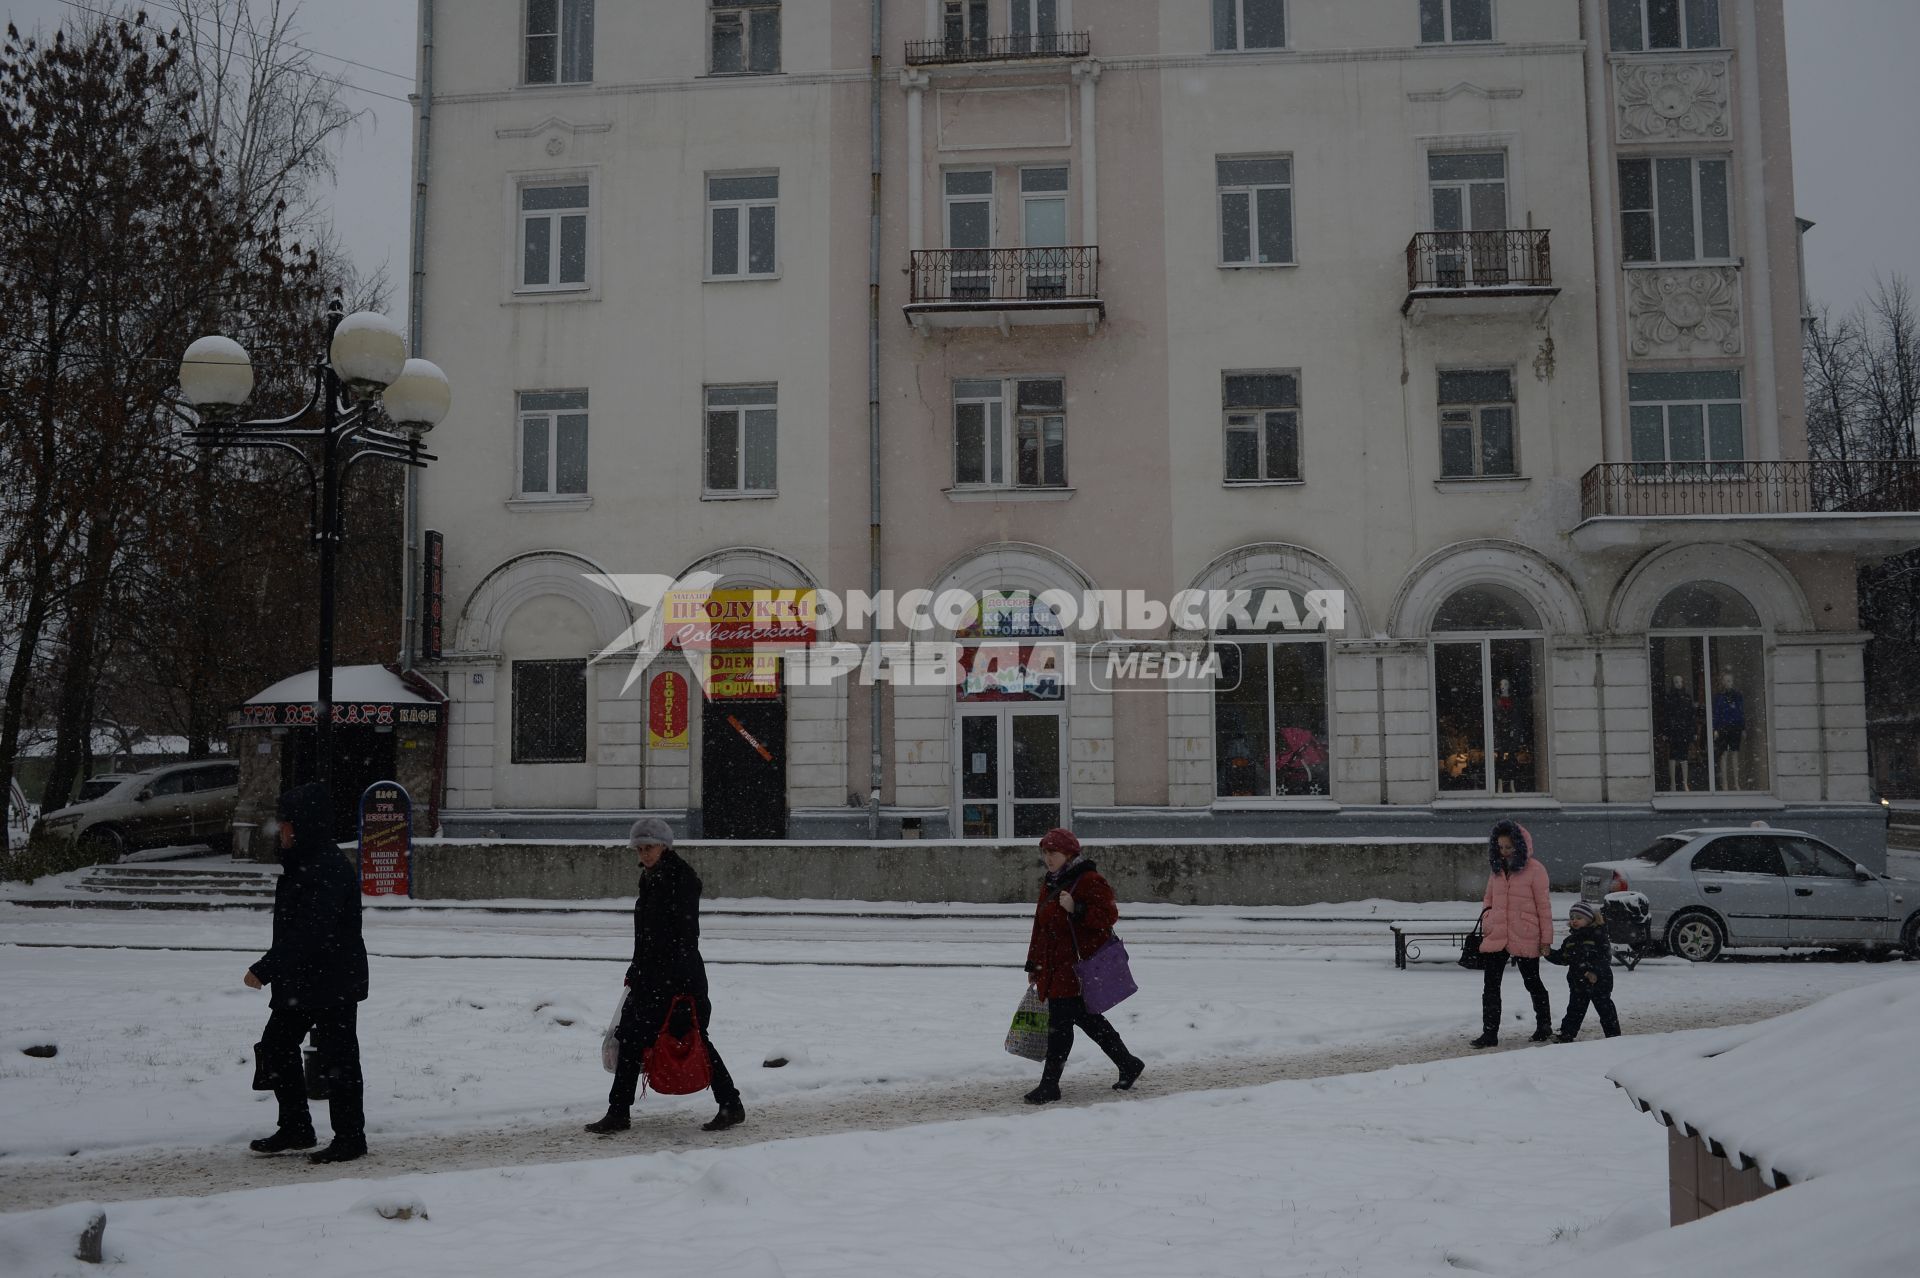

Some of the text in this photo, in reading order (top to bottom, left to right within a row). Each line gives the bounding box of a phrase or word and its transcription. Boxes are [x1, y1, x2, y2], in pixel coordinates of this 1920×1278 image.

[672, 600, 808, 621] ПРОДУКТЫ
[984, 612, 1050, 622] КОЛЯСКИ
[672, 622, 811, 647] Советский
[984, 625, 1057, 636] КРОВАТКИ
[708, 681, 777, 695] ПРОДУКТЫ
[663, 671, 675, 738] ПРОДУКТЫ
[243, 705, 277, 724] ТРИ
[399, 708, 437, 724] КАФЕ
[375, 790, 398, 799] КАФЕ
